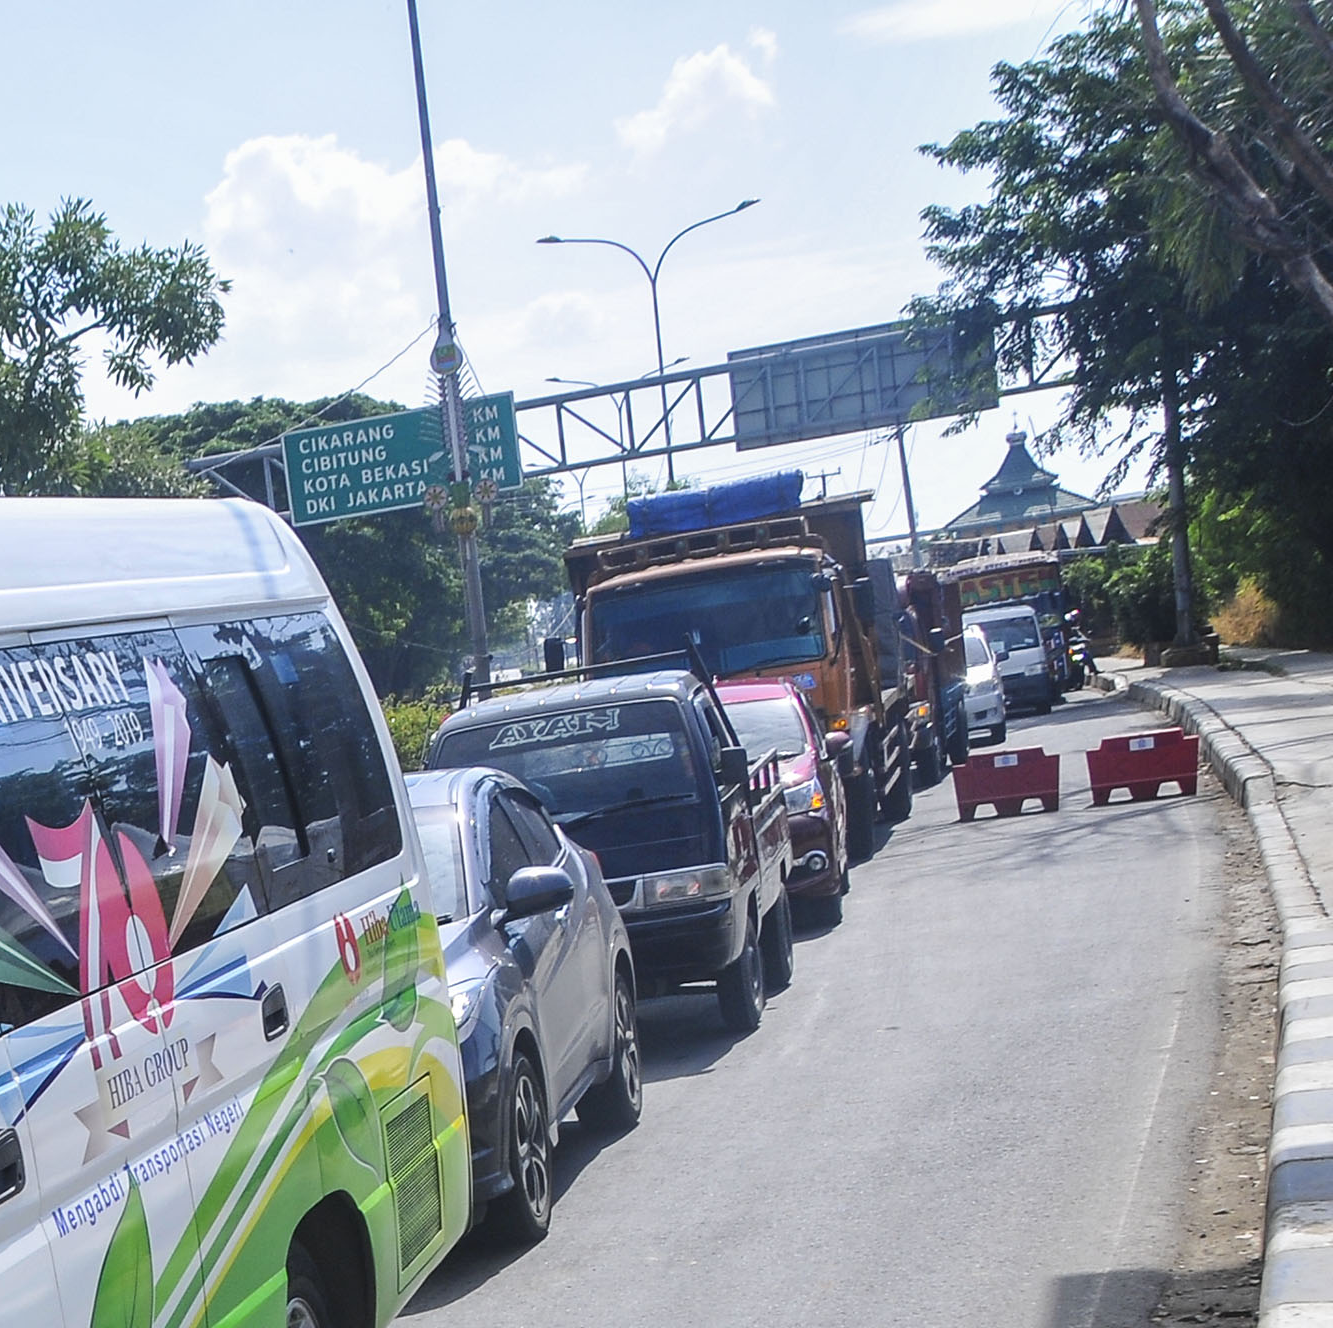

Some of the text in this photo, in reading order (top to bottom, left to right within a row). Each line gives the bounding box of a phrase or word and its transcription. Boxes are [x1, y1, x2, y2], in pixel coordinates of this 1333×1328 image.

[473, 404, 498, 423] KM
[299, 424, 395, 454] CIKARANG
[475, 426, 501, 443] KM
[301, 448, 387, 474] CIBITUNG
[478, 446, 503, 464] KM
[303, 458, 429, 495] KOTA BEKASI
[306, 480, 428, 515] DKI JAKARTA
[63, 718, 103, 752] 1949
[107, 712, 145, 746] 2019
[107, 1038, 189, 1109] HIBA GROUP
[52, 1096, 245, 1238] Mengabdi Transportasi Negeri
